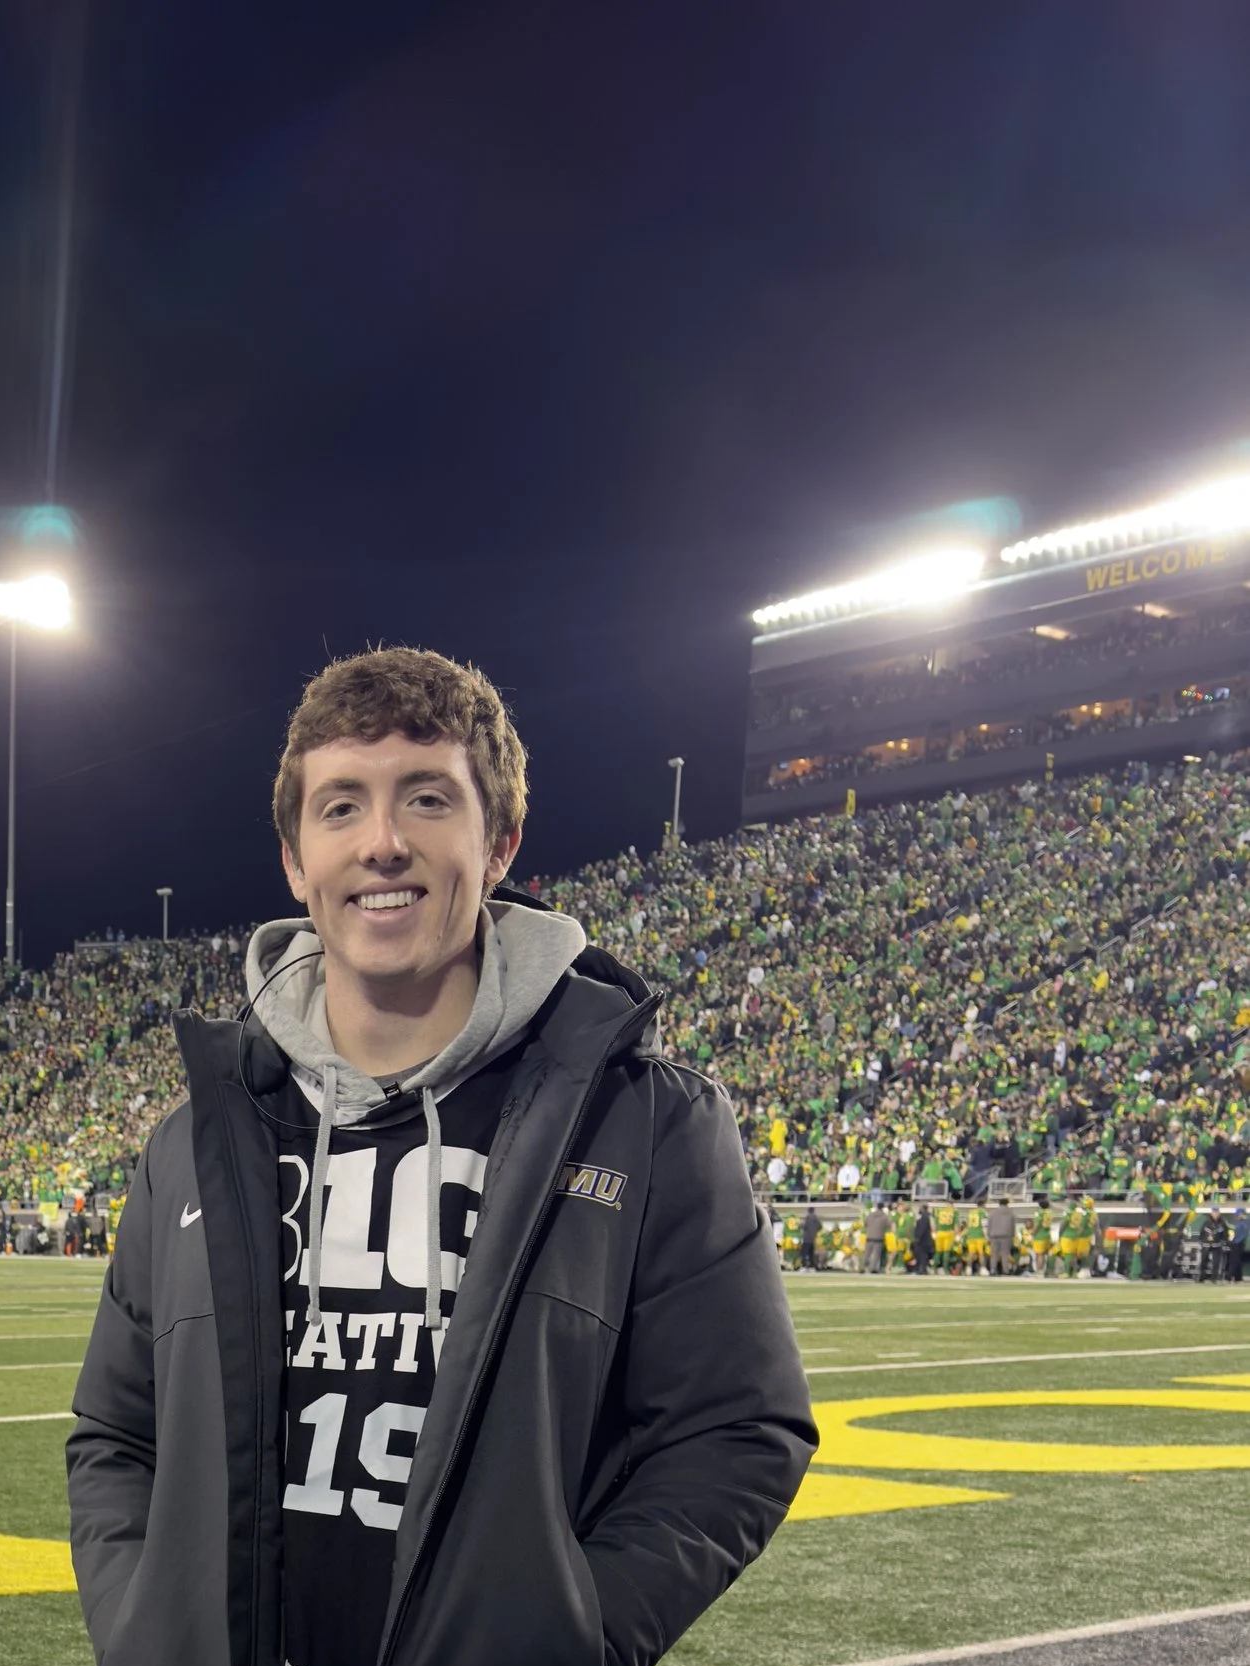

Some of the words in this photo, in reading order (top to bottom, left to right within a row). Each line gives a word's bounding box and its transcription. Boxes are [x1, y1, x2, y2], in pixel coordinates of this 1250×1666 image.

[1085, 540, 1227, 592] WELCOME
[556, 1165, 623, 1201] MU
[285, 1310, 451, 1374] ATI
